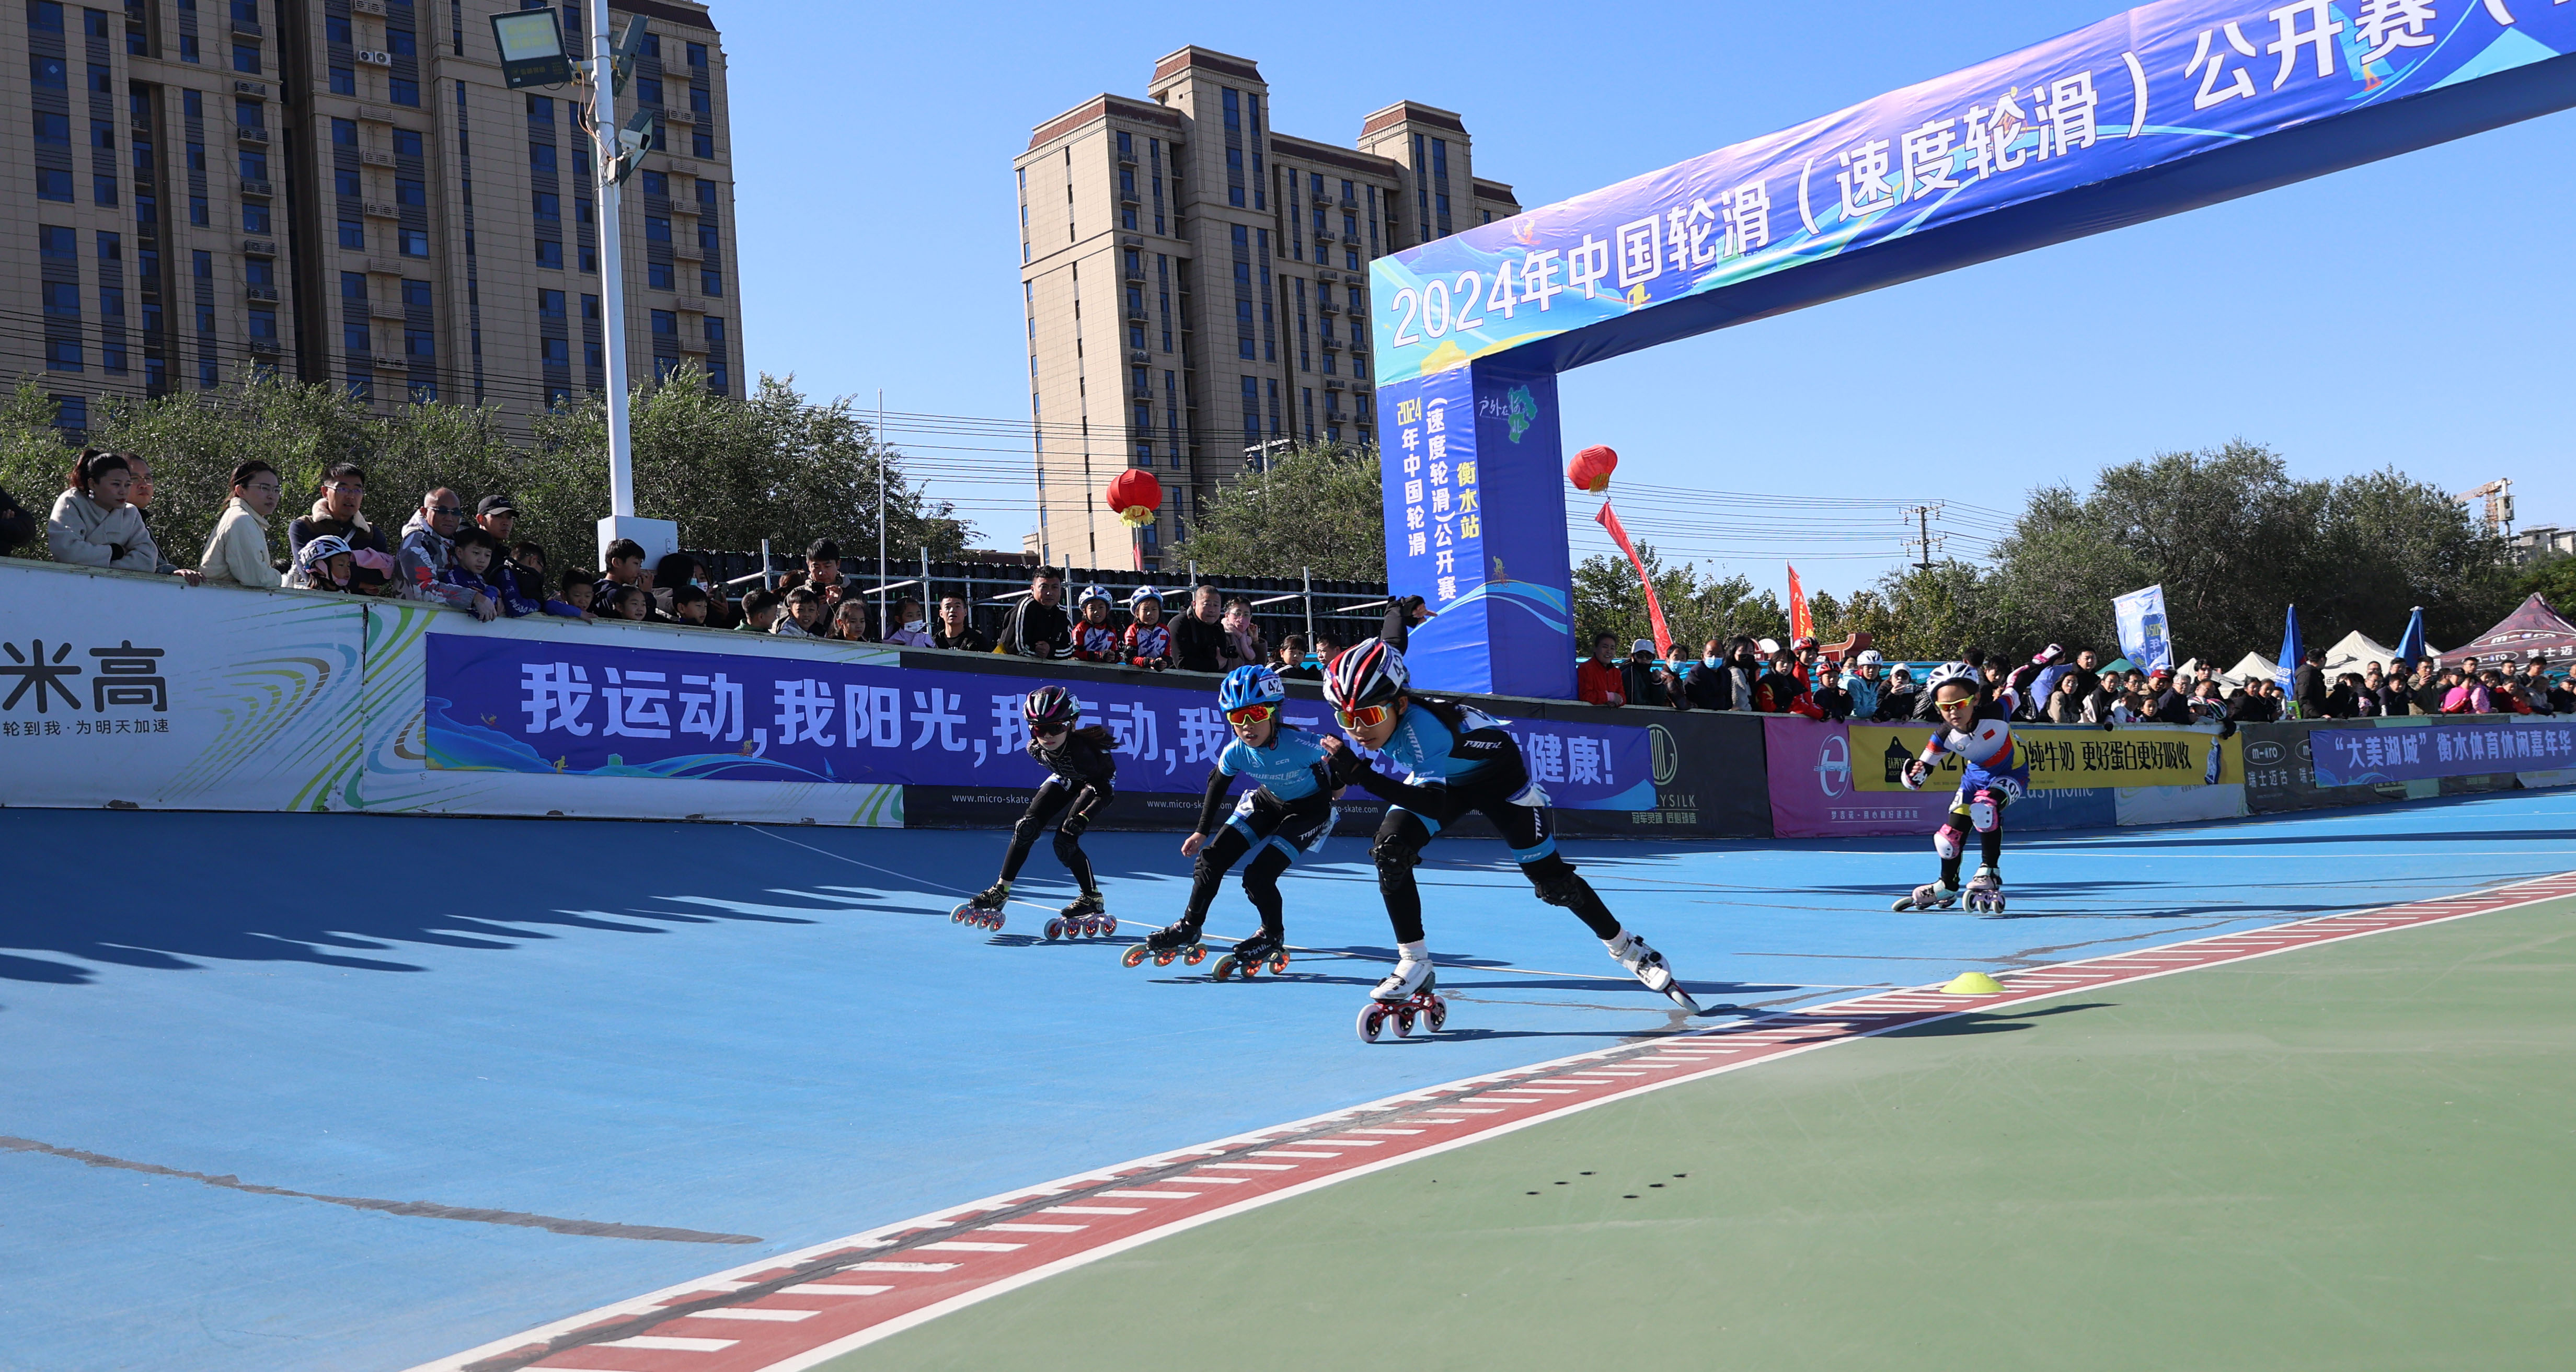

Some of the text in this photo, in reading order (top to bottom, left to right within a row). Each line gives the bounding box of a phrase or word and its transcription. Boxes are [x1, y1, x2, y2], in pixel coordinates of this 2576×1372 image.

[1456, 460, 1480, 539] 衡水站
[0, 639, 168, 714] 米高
[2437, 730, 2571, 762] 衡水体育休闲嘉年华
[2248, 767, 2288, 788] 瑞士迈古
